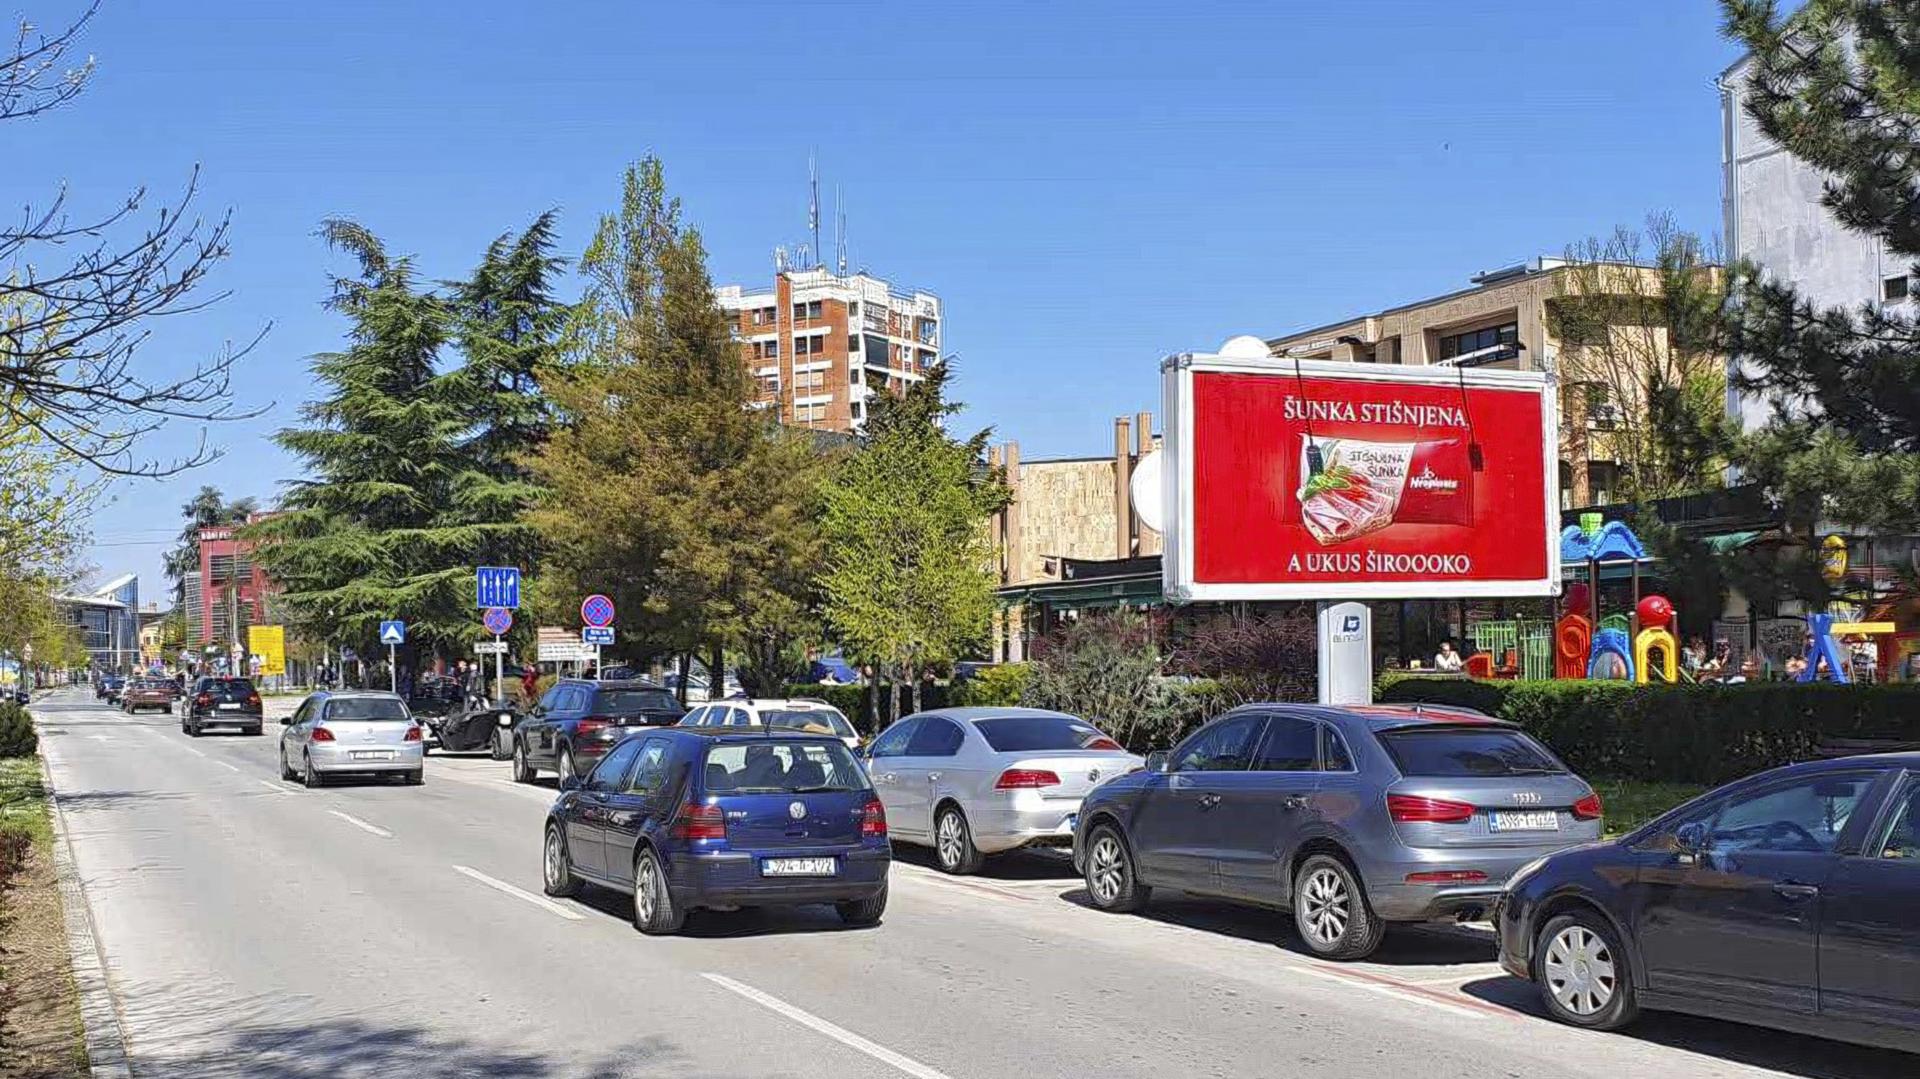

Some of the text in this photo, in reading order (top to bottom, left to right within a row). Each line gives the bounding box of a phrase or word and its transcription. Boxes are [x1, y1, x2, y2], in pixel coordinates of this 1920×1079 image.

[1284, 395, 1467, 428] ŠUNKA STIŠNJENA
[1287, 549, 1471, 574] A UKUS ŠIROOOKO
